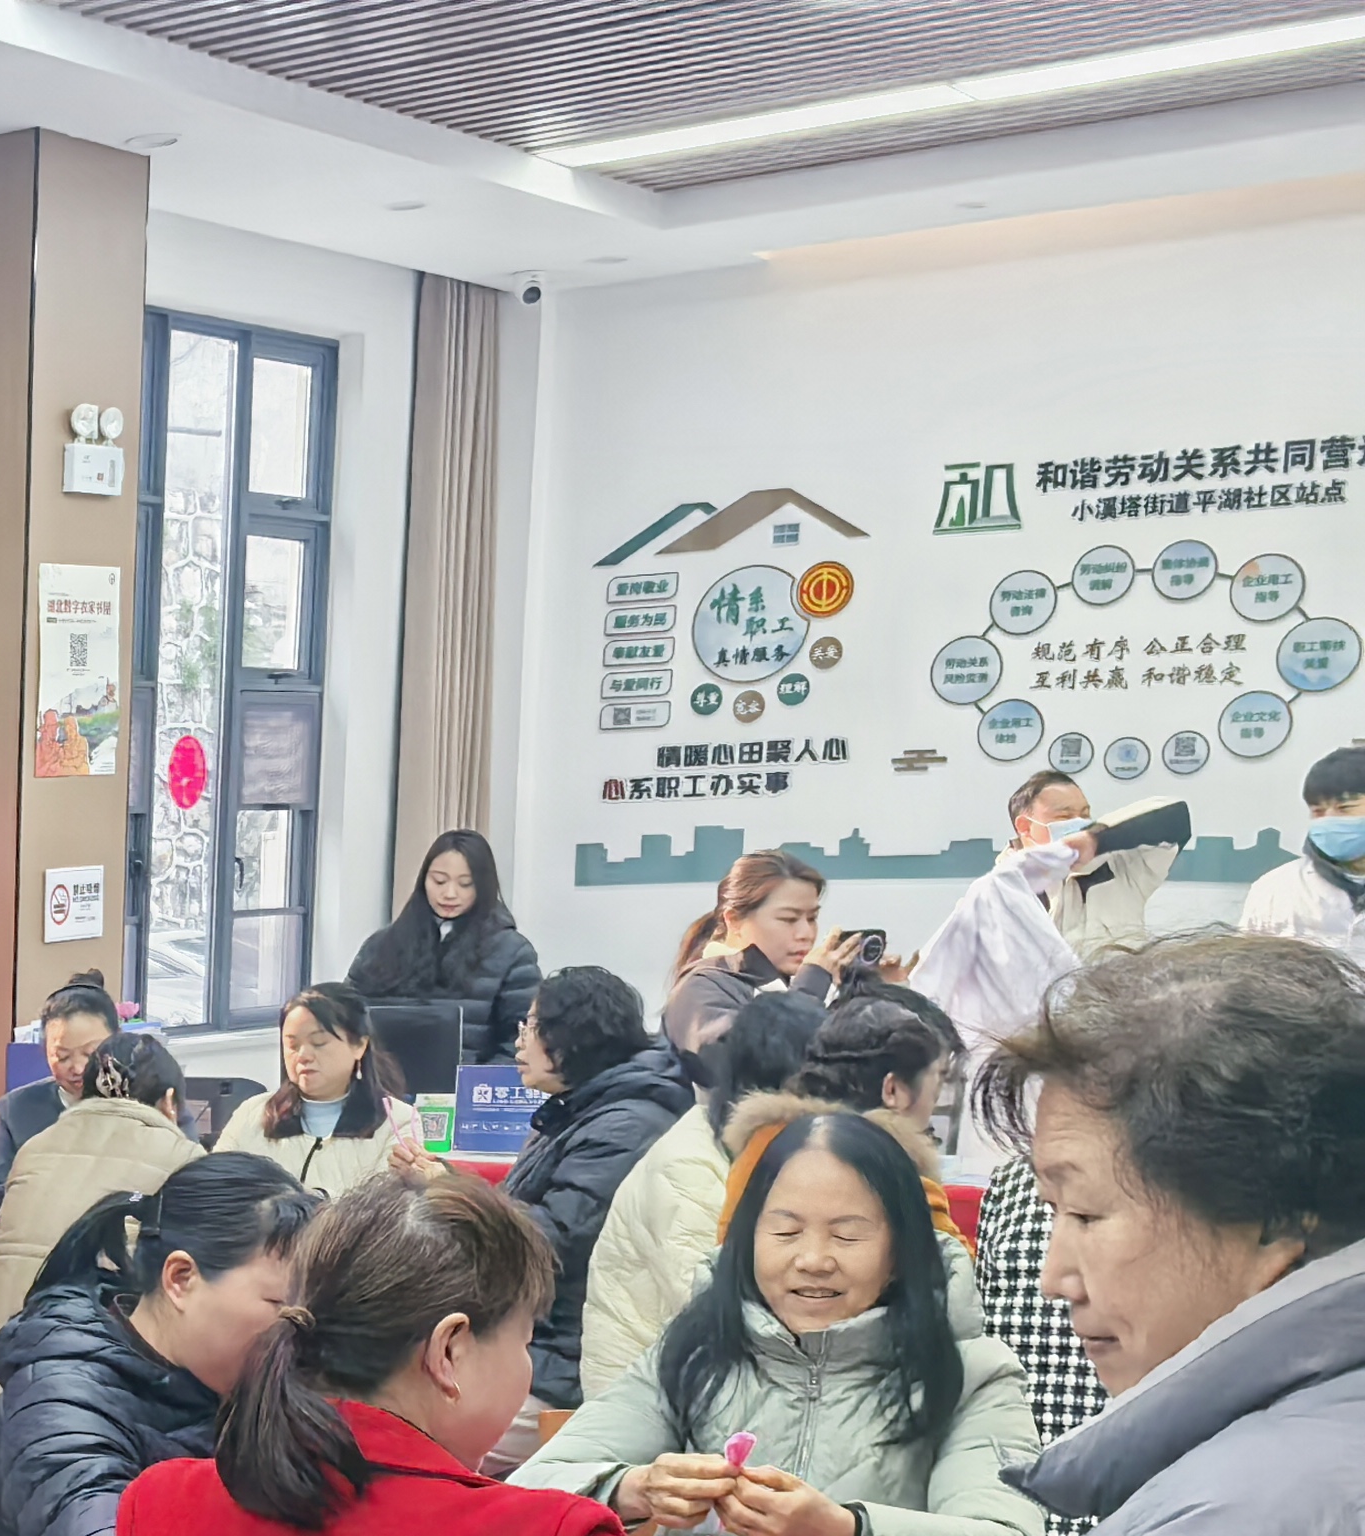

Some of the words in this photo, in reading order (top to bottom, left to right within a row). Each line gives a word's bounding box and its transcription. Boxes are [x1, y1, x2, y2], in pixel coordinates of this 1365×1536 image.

[1071, 479, 1347, 522] 小溪塔街道平湖社区站点
[616, 580, 669, 596] 爱岗敬业
[1242, 574, 1294, 588] 企业用工
[1001, 588, 1047, 602] 劳动法律
[47, 600, 112, 616] 湖北数字农家书屋
[613, 612, 667, 629] 服务为民
[1031, 635, 1131, 663] 规范有序
[1143, 632, 1247, 656] 公正合理
[714, 646, 791, 669] 真情服务
[945, 657, 989, 669] 劳动关系
[1029, 665, 1128, 690] 互利共赢
[1141, 660, 1245, 687] 和谐稳定
[609, 676, 663, 693] 与爱同行
[778, 681, 808, 697] 理解
[988, 716, 1034, 729] 企业用工
[1230, 710, 1281, 724] 企业文化
[657, 738, 847, 768] 情暖心田聚人心
[603, 771, 791, 801] 心系职工办实事
